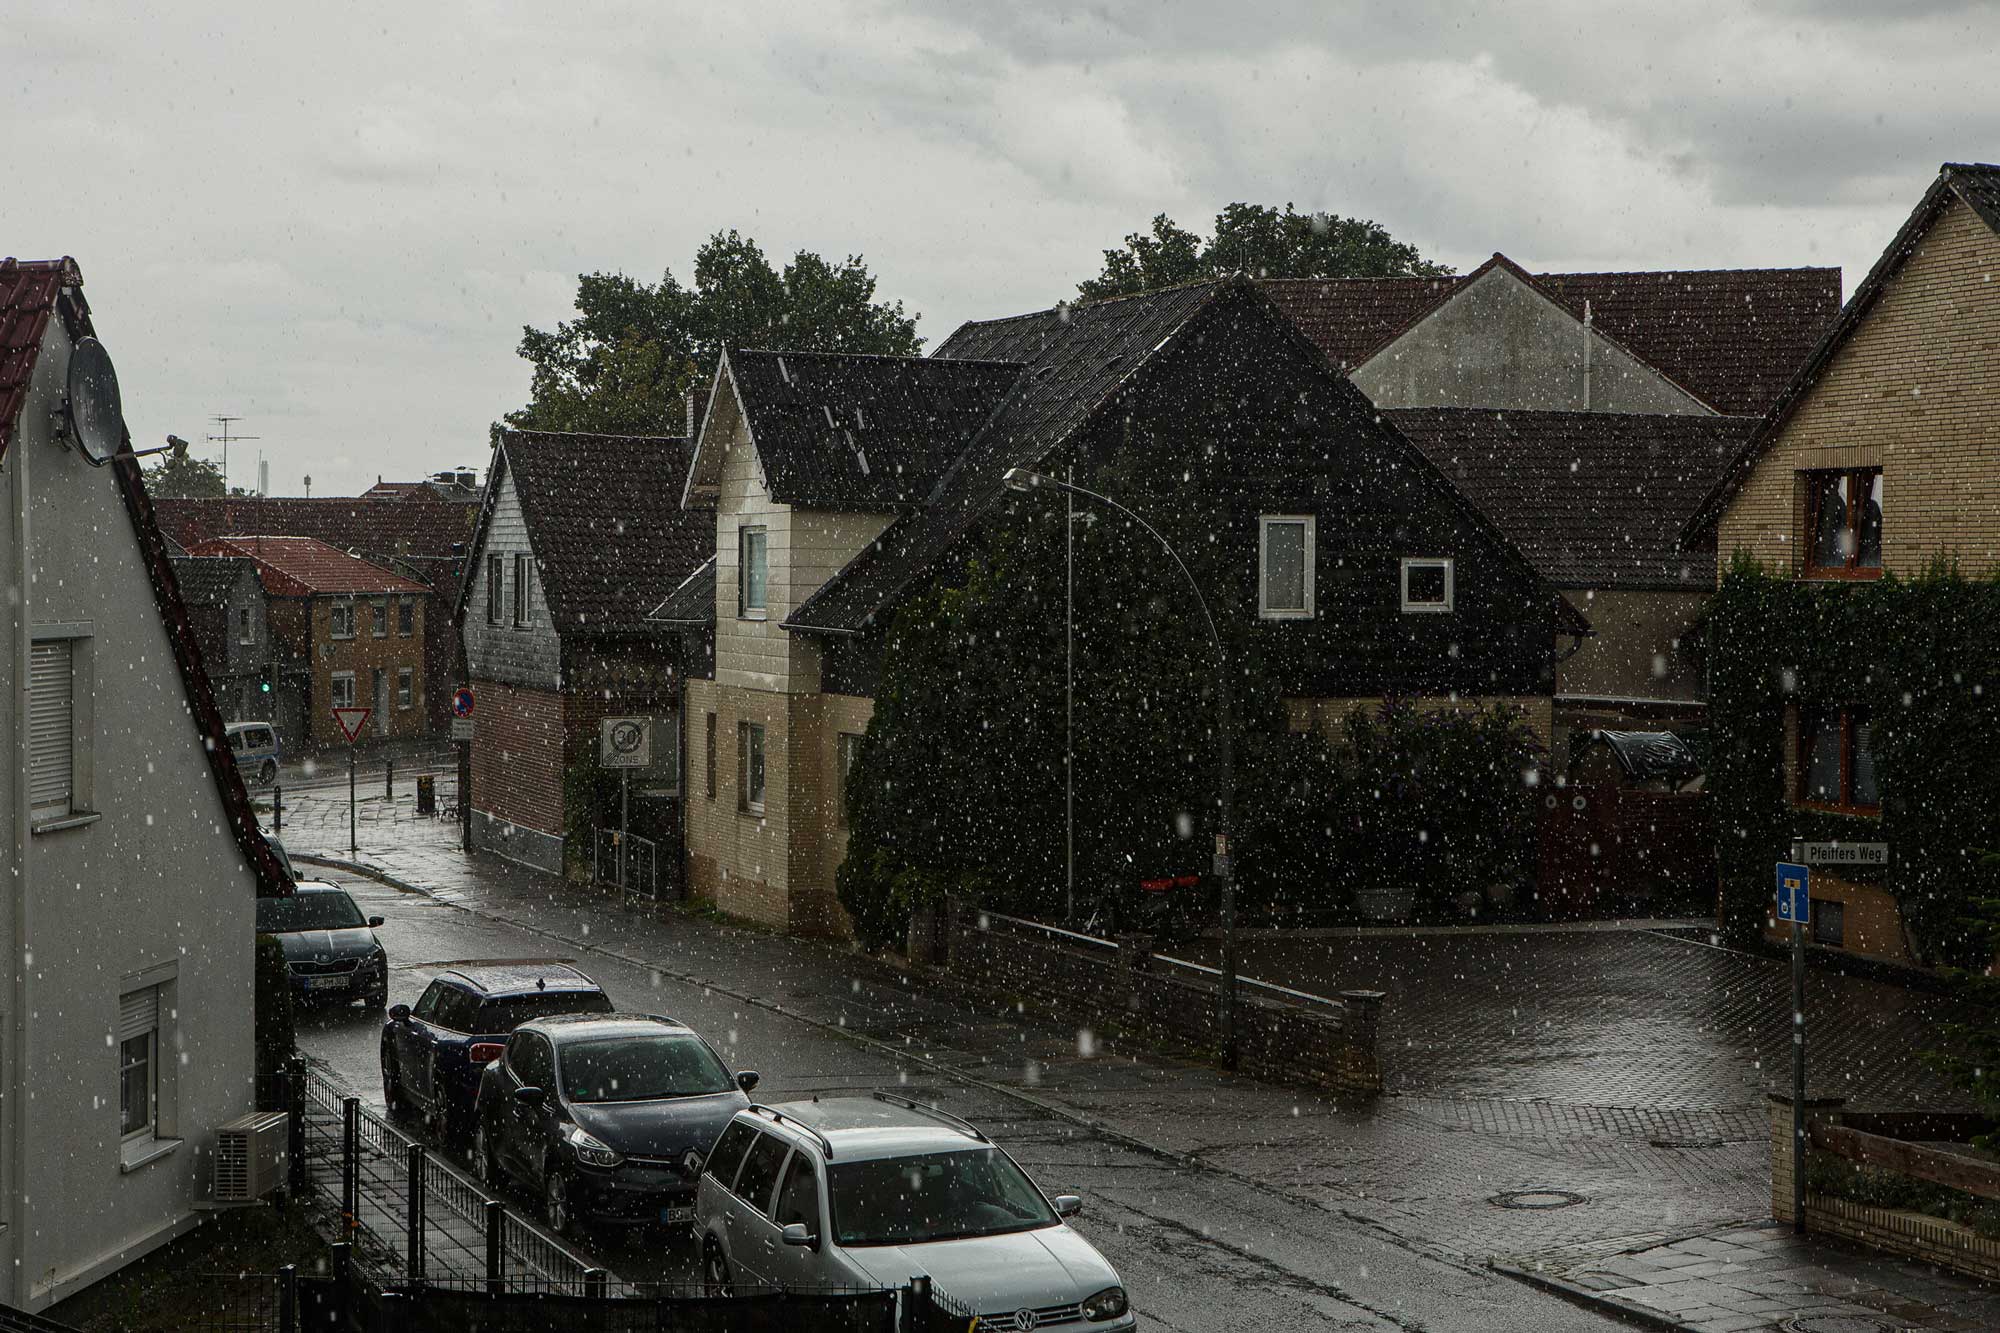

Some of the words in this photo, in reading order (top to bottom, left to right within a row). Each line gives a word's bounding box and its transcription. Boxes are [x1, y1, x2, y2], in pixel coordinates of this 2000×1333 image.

[617, 730, 637, 744] 30
[614, 755, 639, 764] ZONE
[1810, 846, 1856, 860] Pfeiffers
[1859, 846, 1882, 863] Weg
[1015, 1309, 1035, 1331] VW
